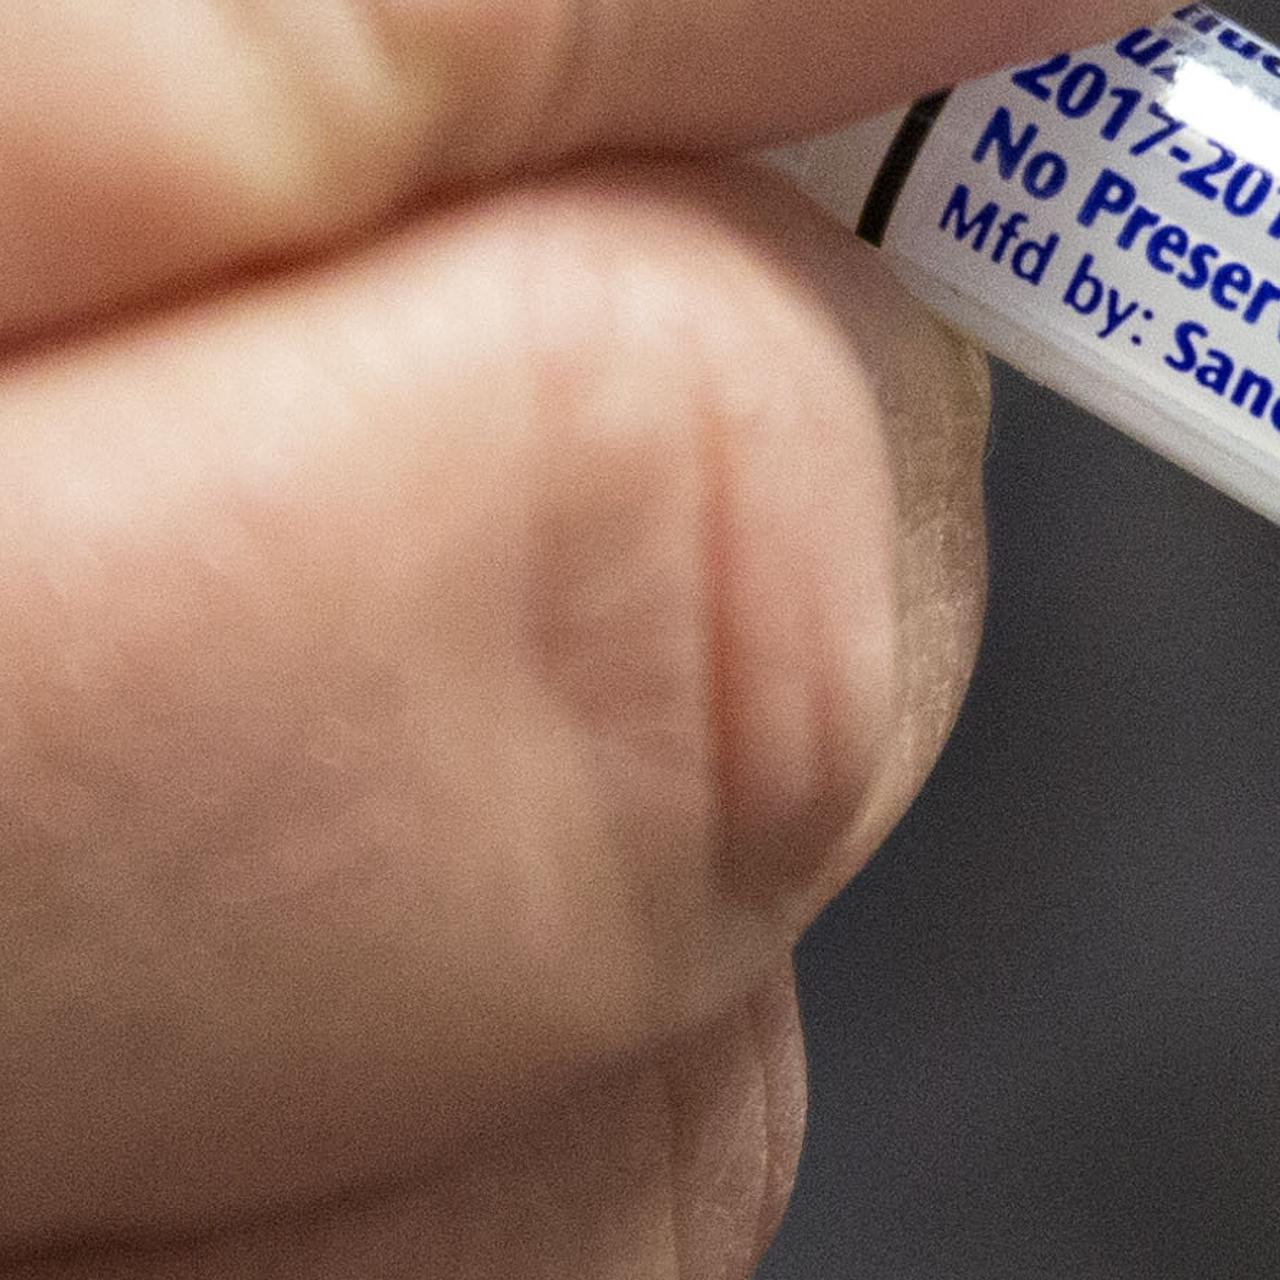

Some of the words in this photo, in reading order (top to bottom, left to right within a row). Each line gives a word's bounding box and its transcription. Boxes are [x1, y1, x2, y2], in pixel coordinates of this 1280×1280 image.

[971, 106, 1069, 201] No
[938, 182, 1061, 287] Mfd
[1062, 253, 1155, 347] by:
